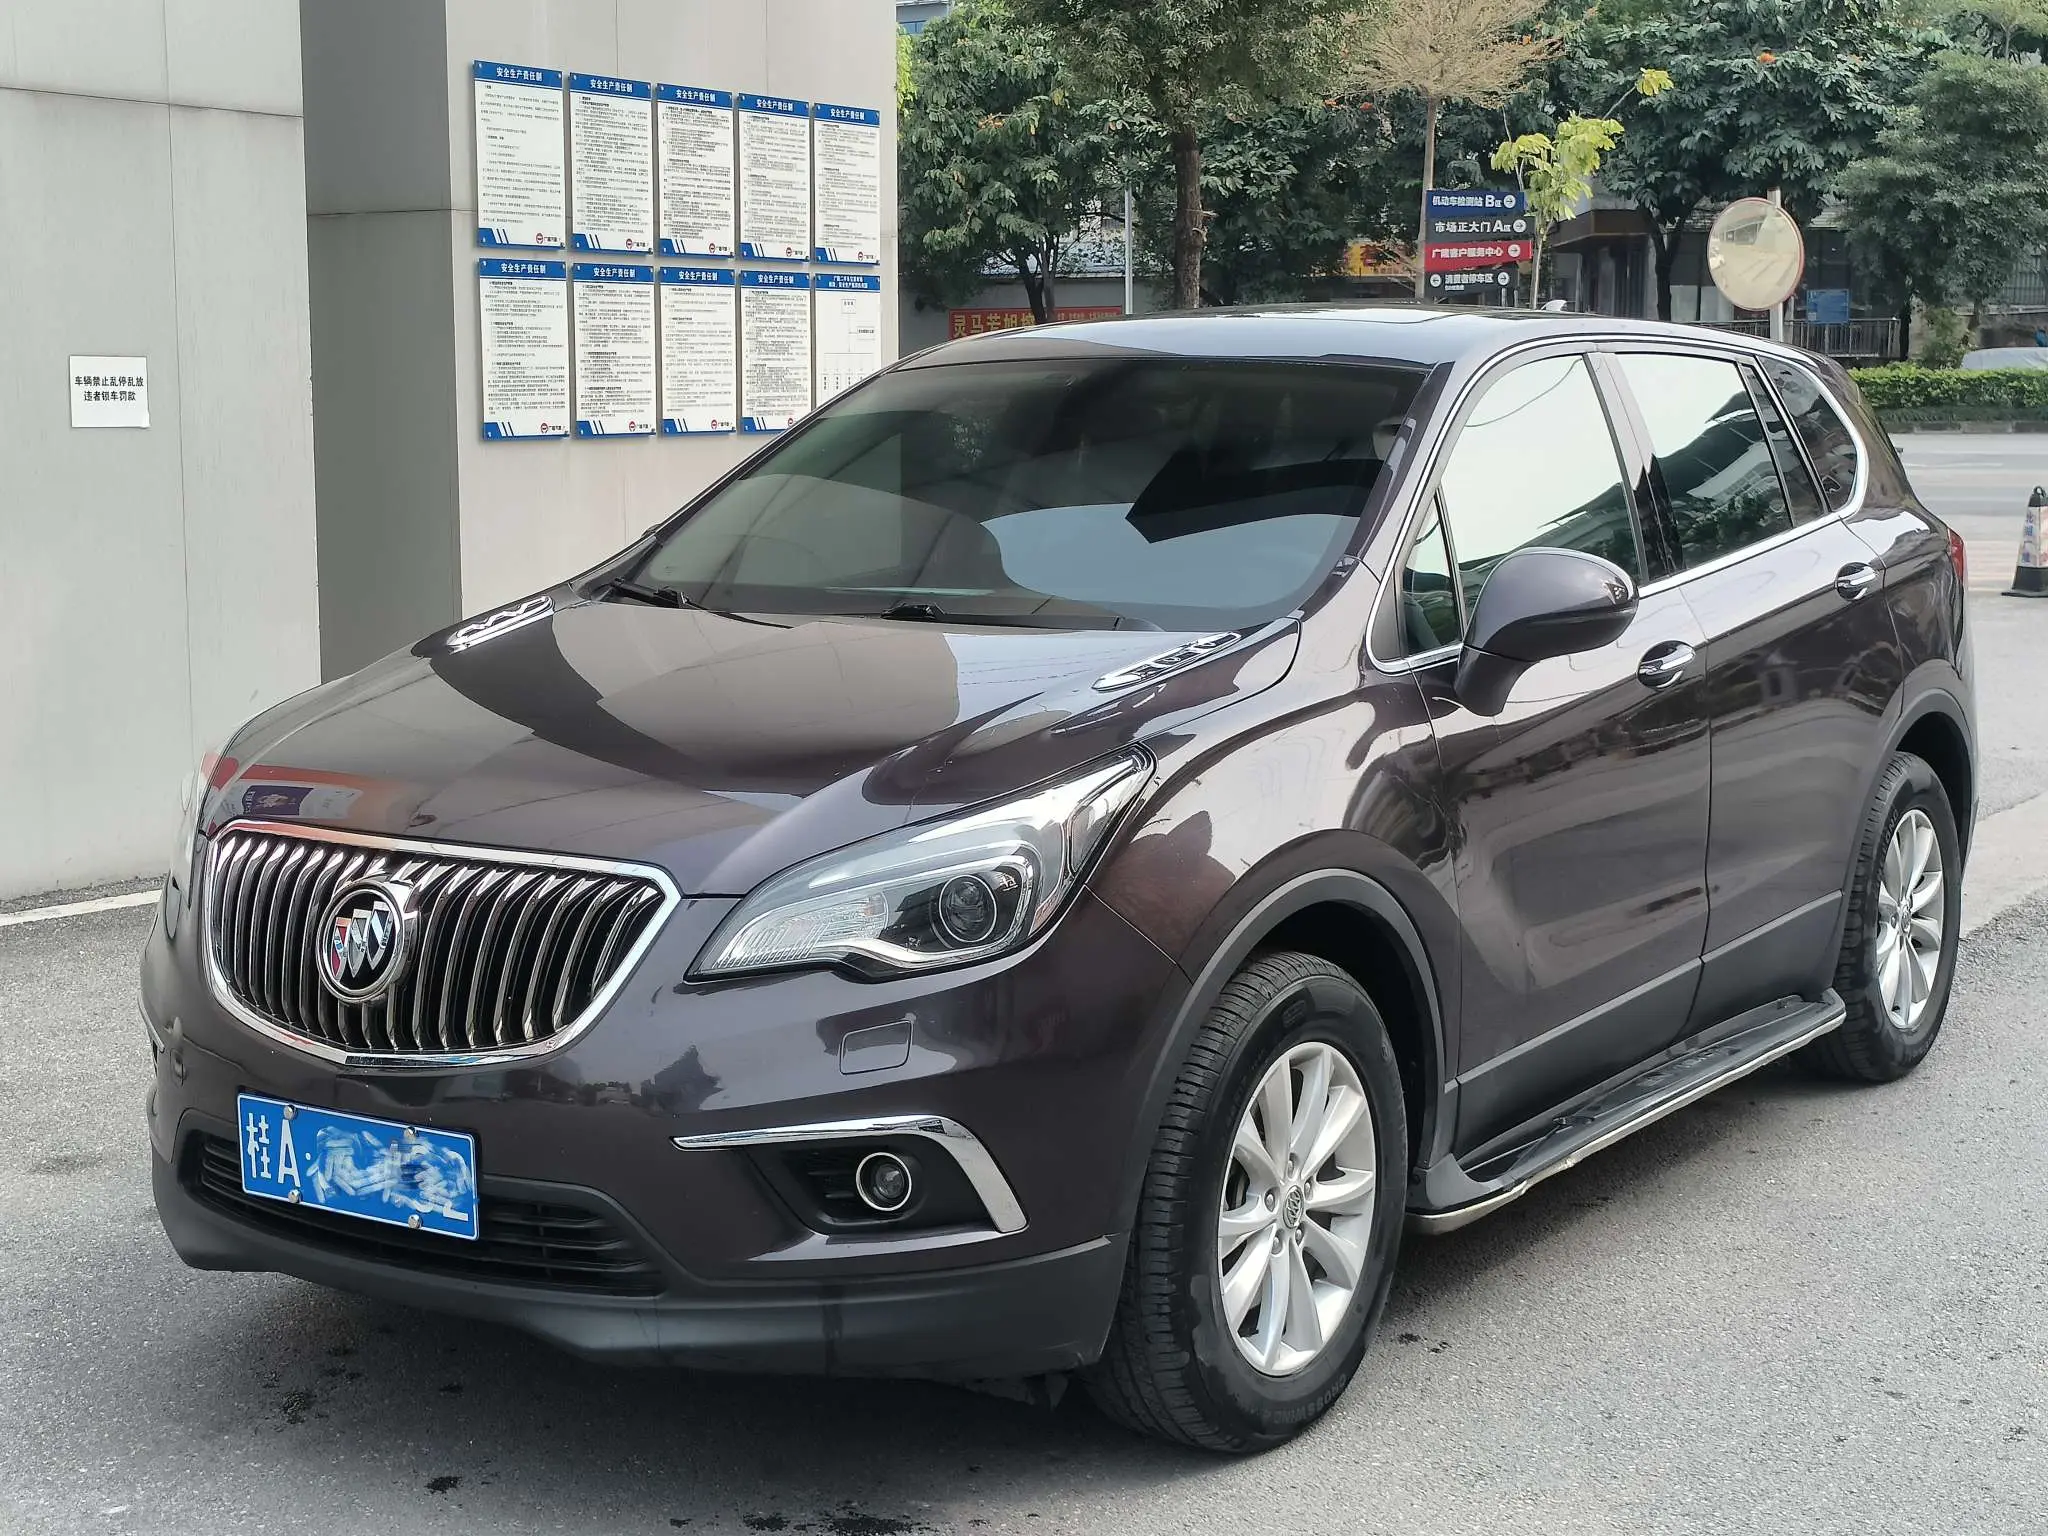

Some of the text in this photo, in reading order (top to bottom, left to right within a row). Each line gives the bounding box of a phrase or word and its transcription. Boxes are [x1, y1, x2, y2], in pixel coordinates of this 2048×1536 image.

[496, 67, 543, 82] 安全生产责任制
[589, 78, 633, 93] 安全生产责任制
[675, 89, 716, 103] 安全生产责任制
[756, 99, 793, 112] 安全生产责任制
[830, 109, 865, 121] 安全生产责任制
[501, 262, 546, 274] 安全生产责任制
[593, 267, 636, 278] 安全生产责任制
[678, 270, 718, 281] 安全生产责任制
[757, 273, 795, 285] 安全生产责任制
[74, 375, 144, 387] 车辆禁止乱停乱放
[83, 390, 136, 402] 违者锁车罚款
